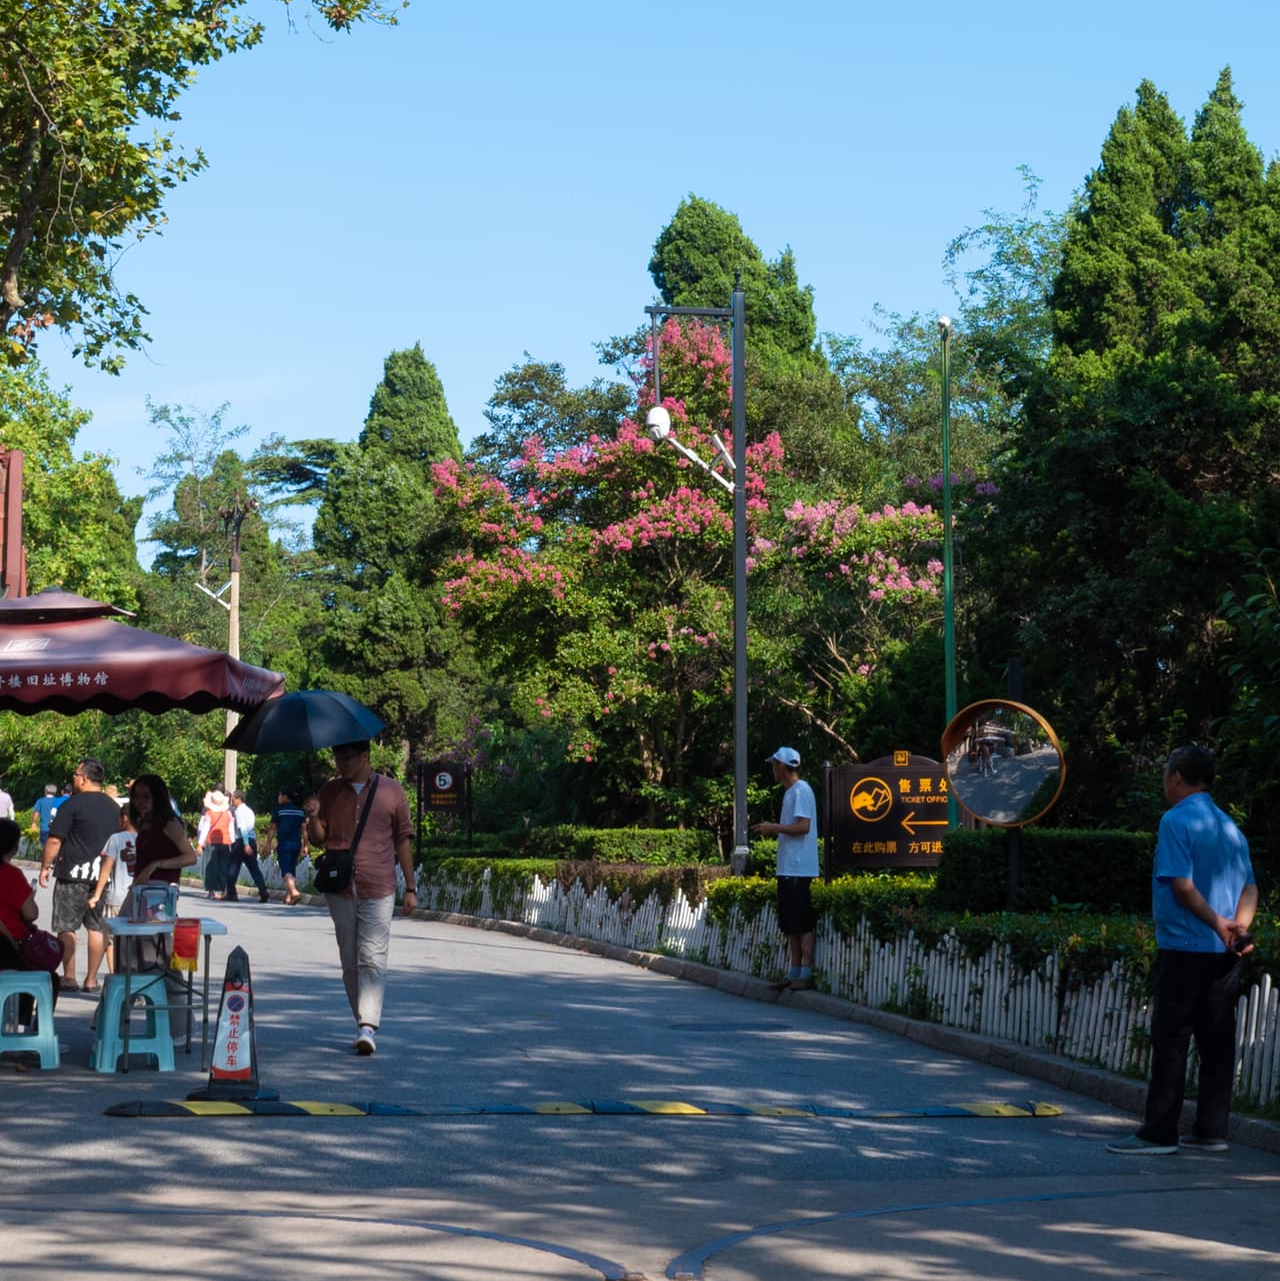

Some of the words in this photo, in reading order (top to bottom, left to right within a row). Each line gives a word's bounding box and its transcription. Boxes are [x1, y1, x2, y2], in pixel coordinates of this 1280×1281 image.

[901, 796, 925, 804] TICKET
[926, 796, 948, 804] OFFIC
[852, 841, 897, 854] 在此购票
[909, 840, 945, 854] 方可进
[226, 1014, 240, 1068] 禁止停车
